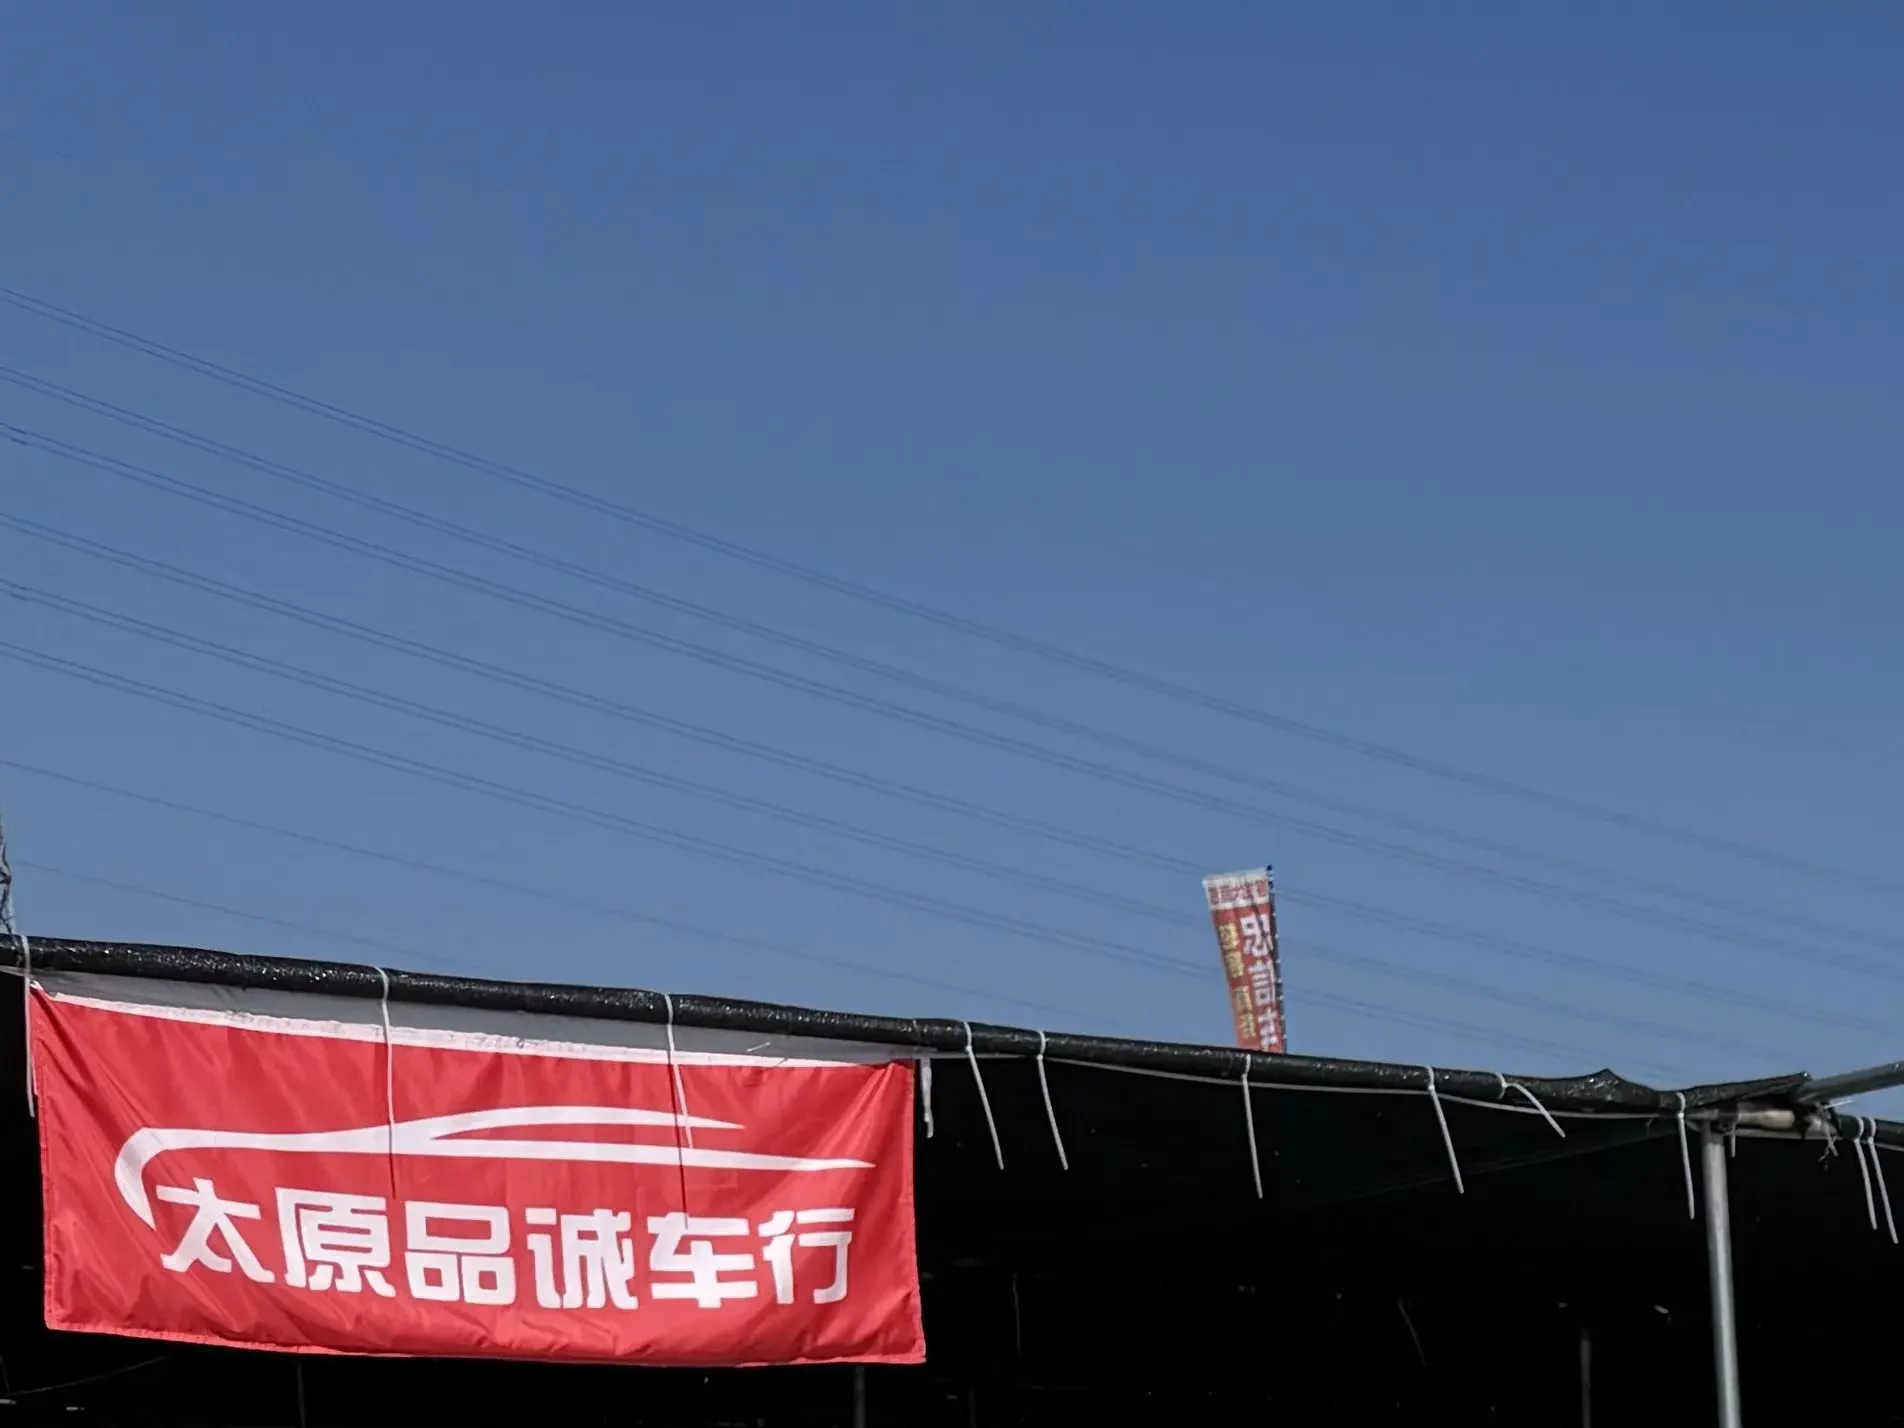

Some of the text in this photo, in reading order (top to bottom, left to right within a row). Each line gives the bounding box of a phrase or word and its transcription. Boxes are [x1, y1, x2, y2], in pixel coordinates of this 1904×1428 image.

[156, 1177, 857, 1310] 太原品诚车行
